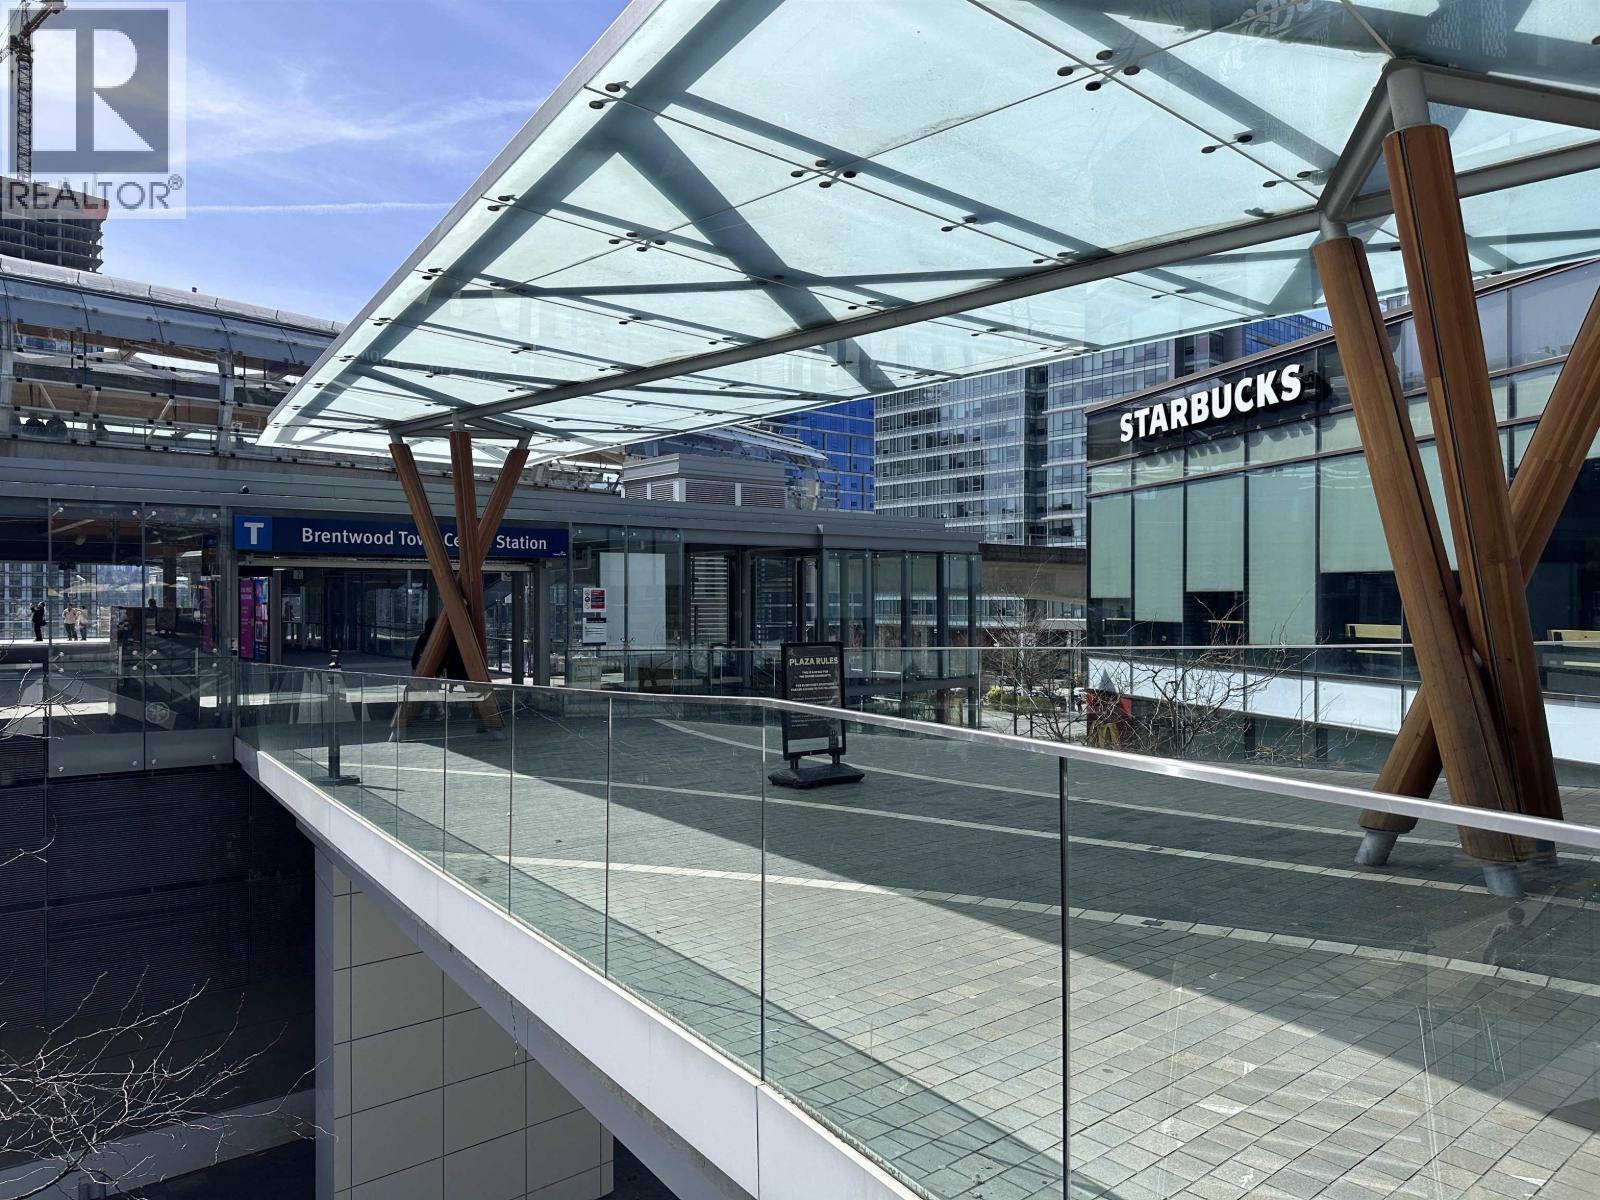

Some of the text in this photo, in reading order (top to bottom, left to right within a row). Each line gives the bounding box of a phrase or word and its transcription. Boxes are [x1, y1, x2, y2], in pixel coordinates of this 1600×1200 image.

[1120, 364, 1301, 443] STARBUCKS
[243, 521, 265, 545] T
[302, 527, 394, 545] Brentwood
[496, 534, 547, 550] Station
[789, 656, 839, 666] PLAZA RULES
